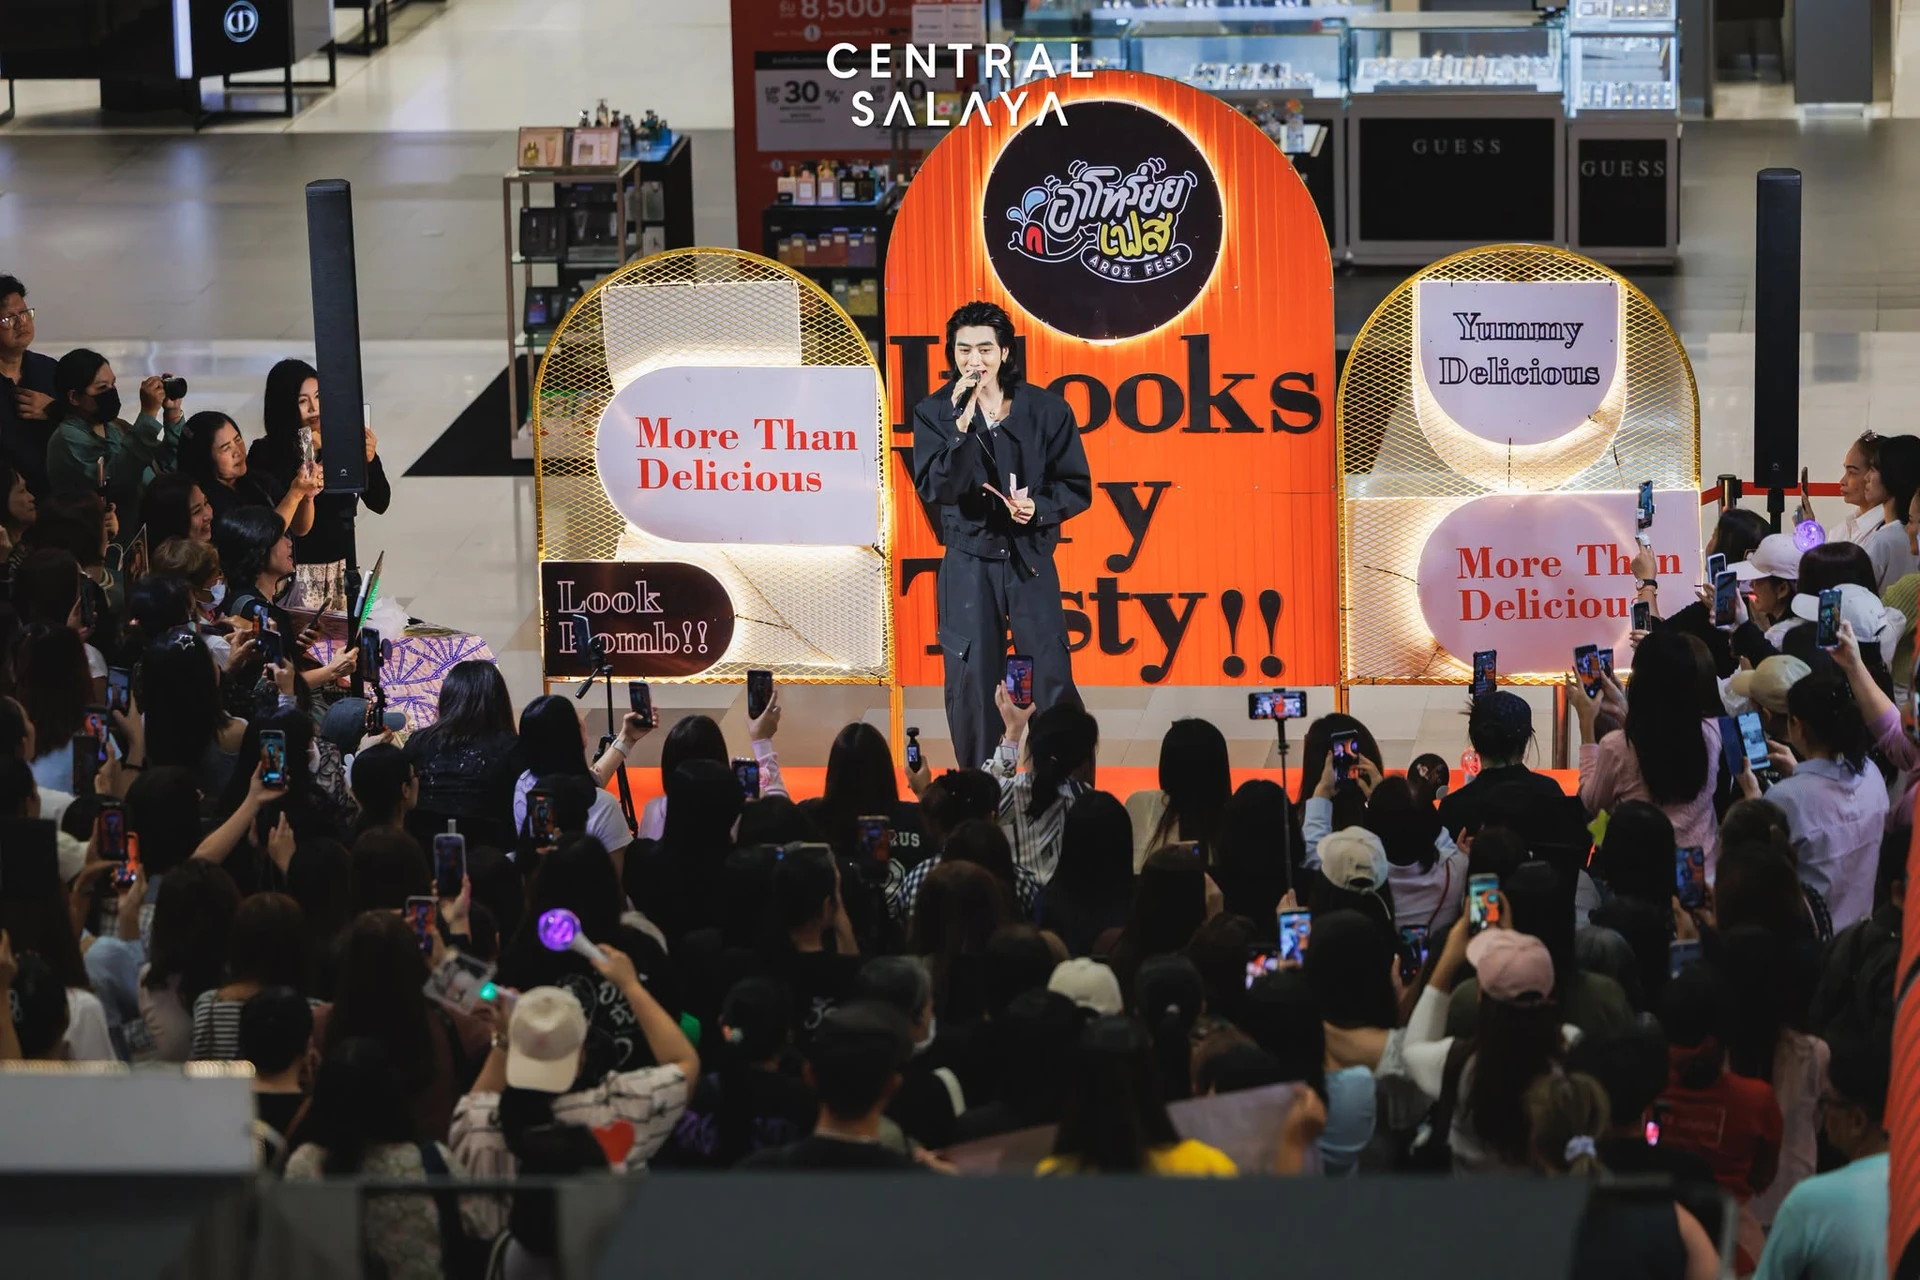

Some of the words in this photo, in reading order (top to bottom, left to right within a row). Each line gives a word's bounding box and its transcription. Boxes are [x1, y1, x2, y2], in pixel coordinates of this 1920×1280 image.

[784, 80, 820, 103] 30
[1412, 139, 1501, 155] GUESS
[1581, 160, 1665, 177] GUESS
[1100, 210, 1173, 257] เฟส
[1089, 256, 1131, 278] AROI
[1144, 251, 1184, 276] FEST
[1453, 312, 1583, 349] Yummy
[1439, 356, 1600, 386] Delicious
[635, 417, 739, 450] More
[754, 418, 858, 451] Than
[637, 458, 822, 492] Delicious
[1456, 546, 1562, 580] More
[1576, 542, 1682, 577] Thn
[557, 580, 663, 614] Look
[1459, 588, 1638, 623] Deliciou
